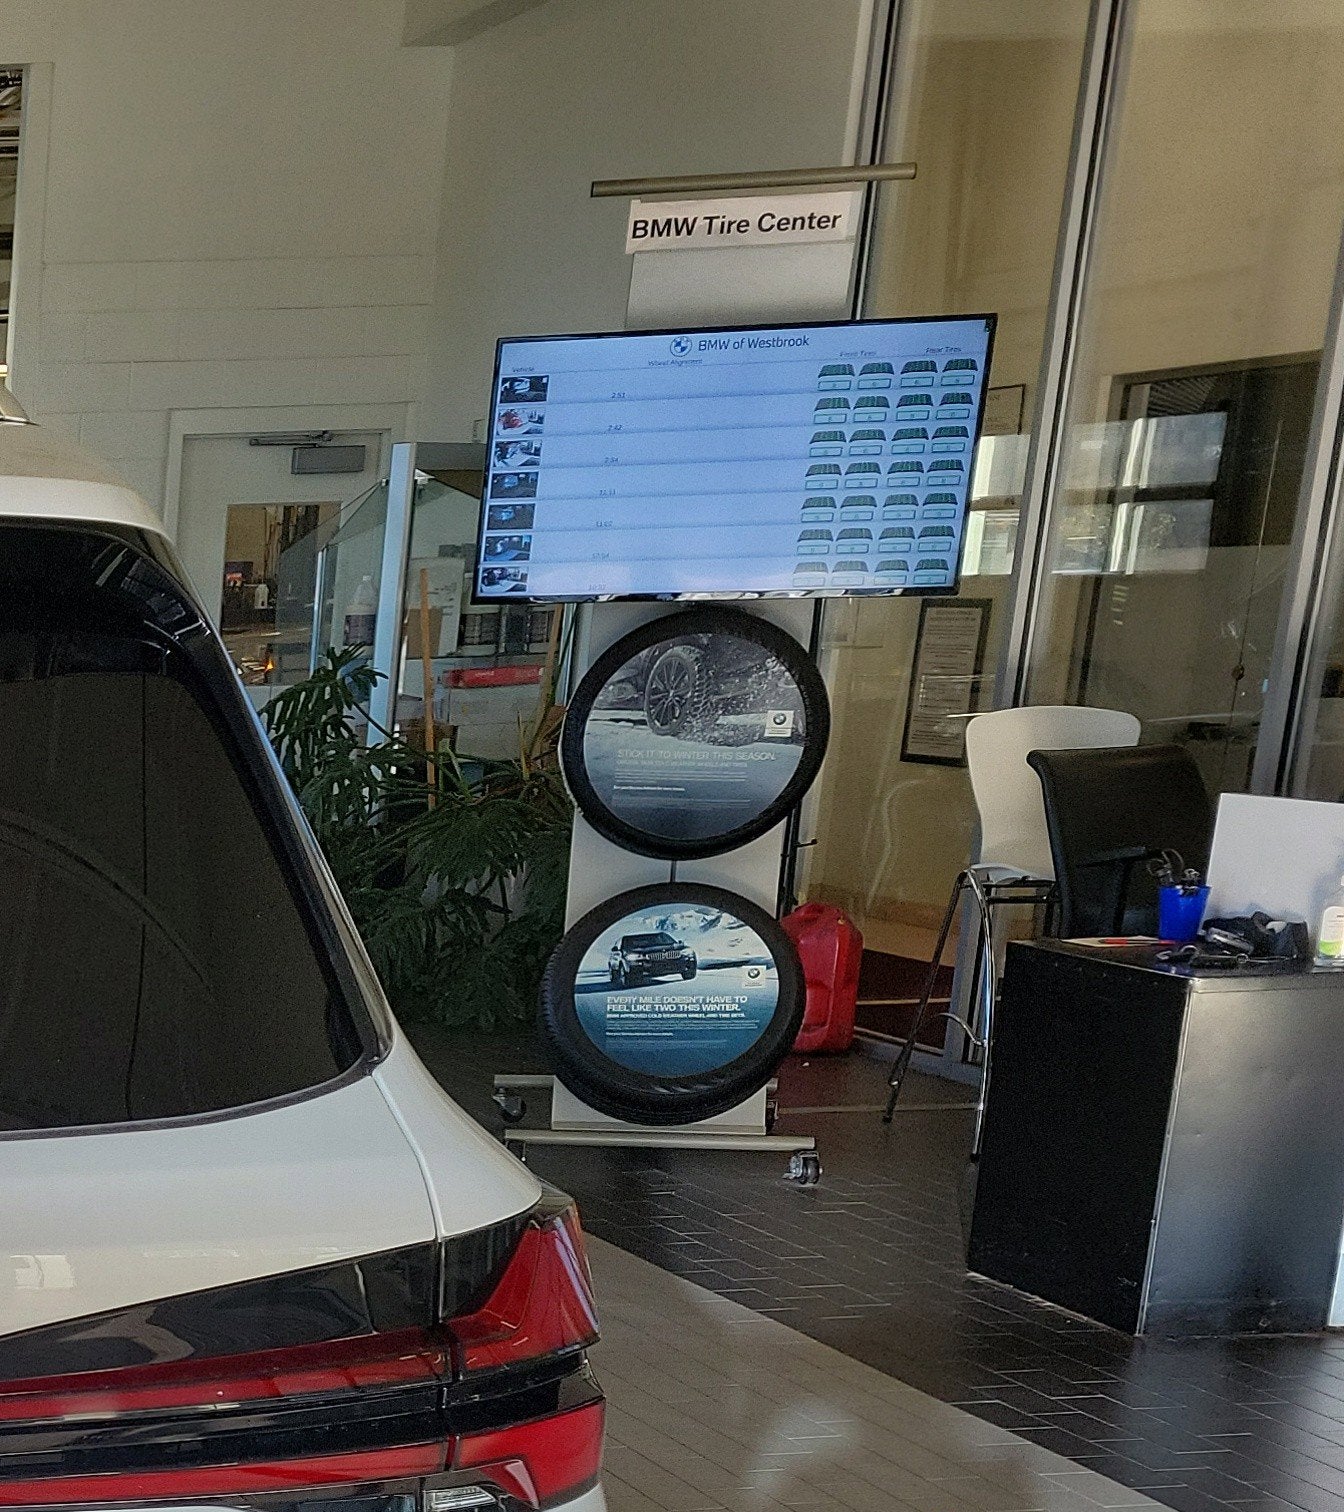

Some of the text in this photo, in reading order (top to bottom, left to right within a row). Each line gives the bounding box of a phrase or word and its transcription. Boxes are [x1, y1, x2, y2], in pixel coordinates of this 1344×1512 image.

[631, 212, 842, 239] BMW Tire Center
[698, 335, 810, 351] BMW of Westbrook
[617, 749, 644, 759] STICK
[645, 749, 656, 759] IT
[659, 750, 671, 759] TO
[673, 750, 711, 760] WINTER
[713, 751, 733, 760] THIS
[607, 996, 748, 1004] EVERY MILE DOESN'T HAVE TO
[606, 1003, 741, 1012] FEEL LIKE TWO THIS WINTER.
